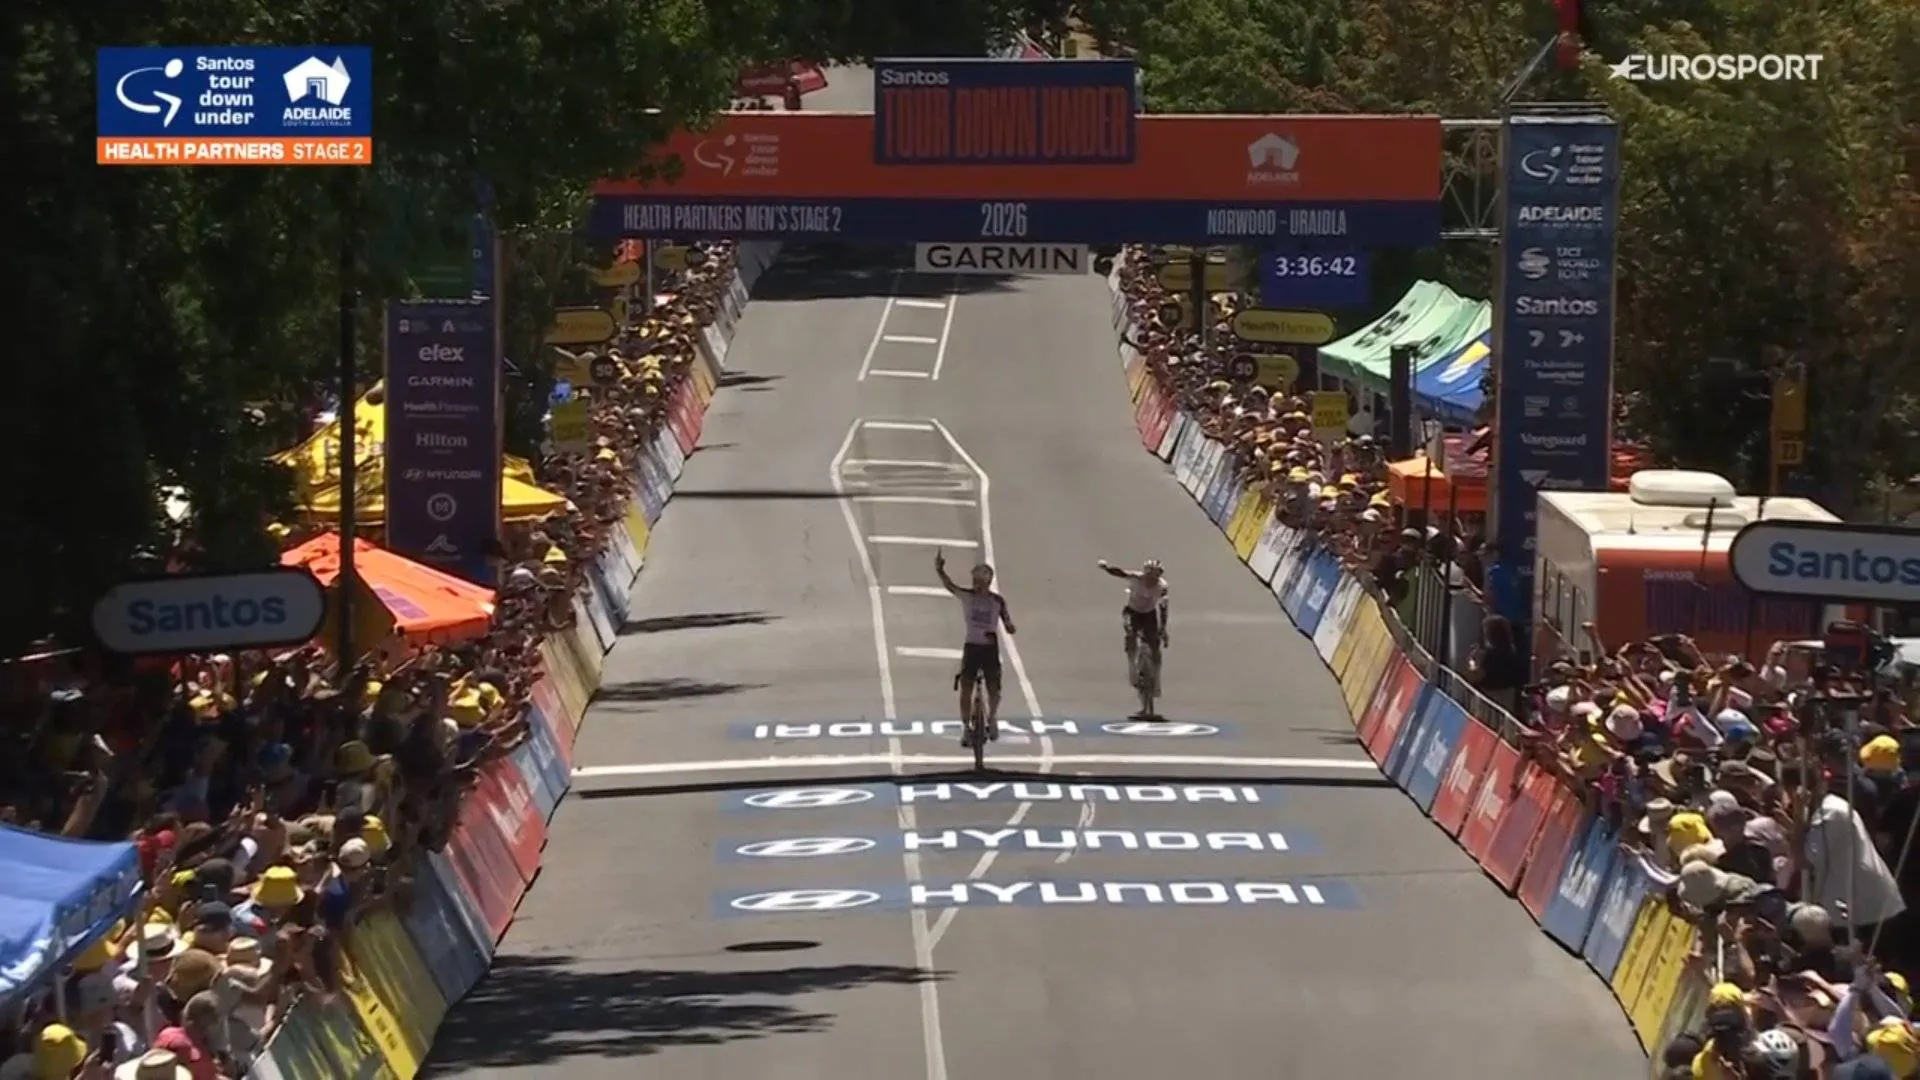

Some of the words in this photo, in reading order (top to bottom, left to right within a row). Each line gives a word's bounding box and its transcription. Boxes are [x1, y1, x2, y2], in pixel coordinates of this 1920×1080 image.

[880, 68, 950, 86] Santos
[884, 87, 949, 158] TOUR
[955, 87, 1037, 158] DOWN
[1042, 87, 1128, 158] UNDER
[623, 204, 671, 230] HEALTH
[674, 204, 743, 231] PARTNERS
[745, 205, 787, 231] MEN'S
[790, 206, 830, 232] STAGE
[831, 207, 842, 232] 2
[980, 202, 1028, 237] 2026
[1206, 209, 1277, 236] NORWOOD
[1289, 209, 1348, 236] URAIDLA
[1518, 206, 1604, 221] ADELAIDE
[926, 245, 1078, 270] GARMIN
[1275, 256, 1357, 276] 3:36:42
[1515, 295, 1599, 316] Santos
[407, 375, 474, 388] GARMIN
[415, 432, 468, 448] Hilton
[1768, 541, 1920, 587] Santos
[126, 593, 287, 637] Santos
[900, 783, 1260, 803] HYUNDAI
[903, 828, 1289, 850] HYUNDAI
[910, 881, 1326, 904] HYUNDAI
